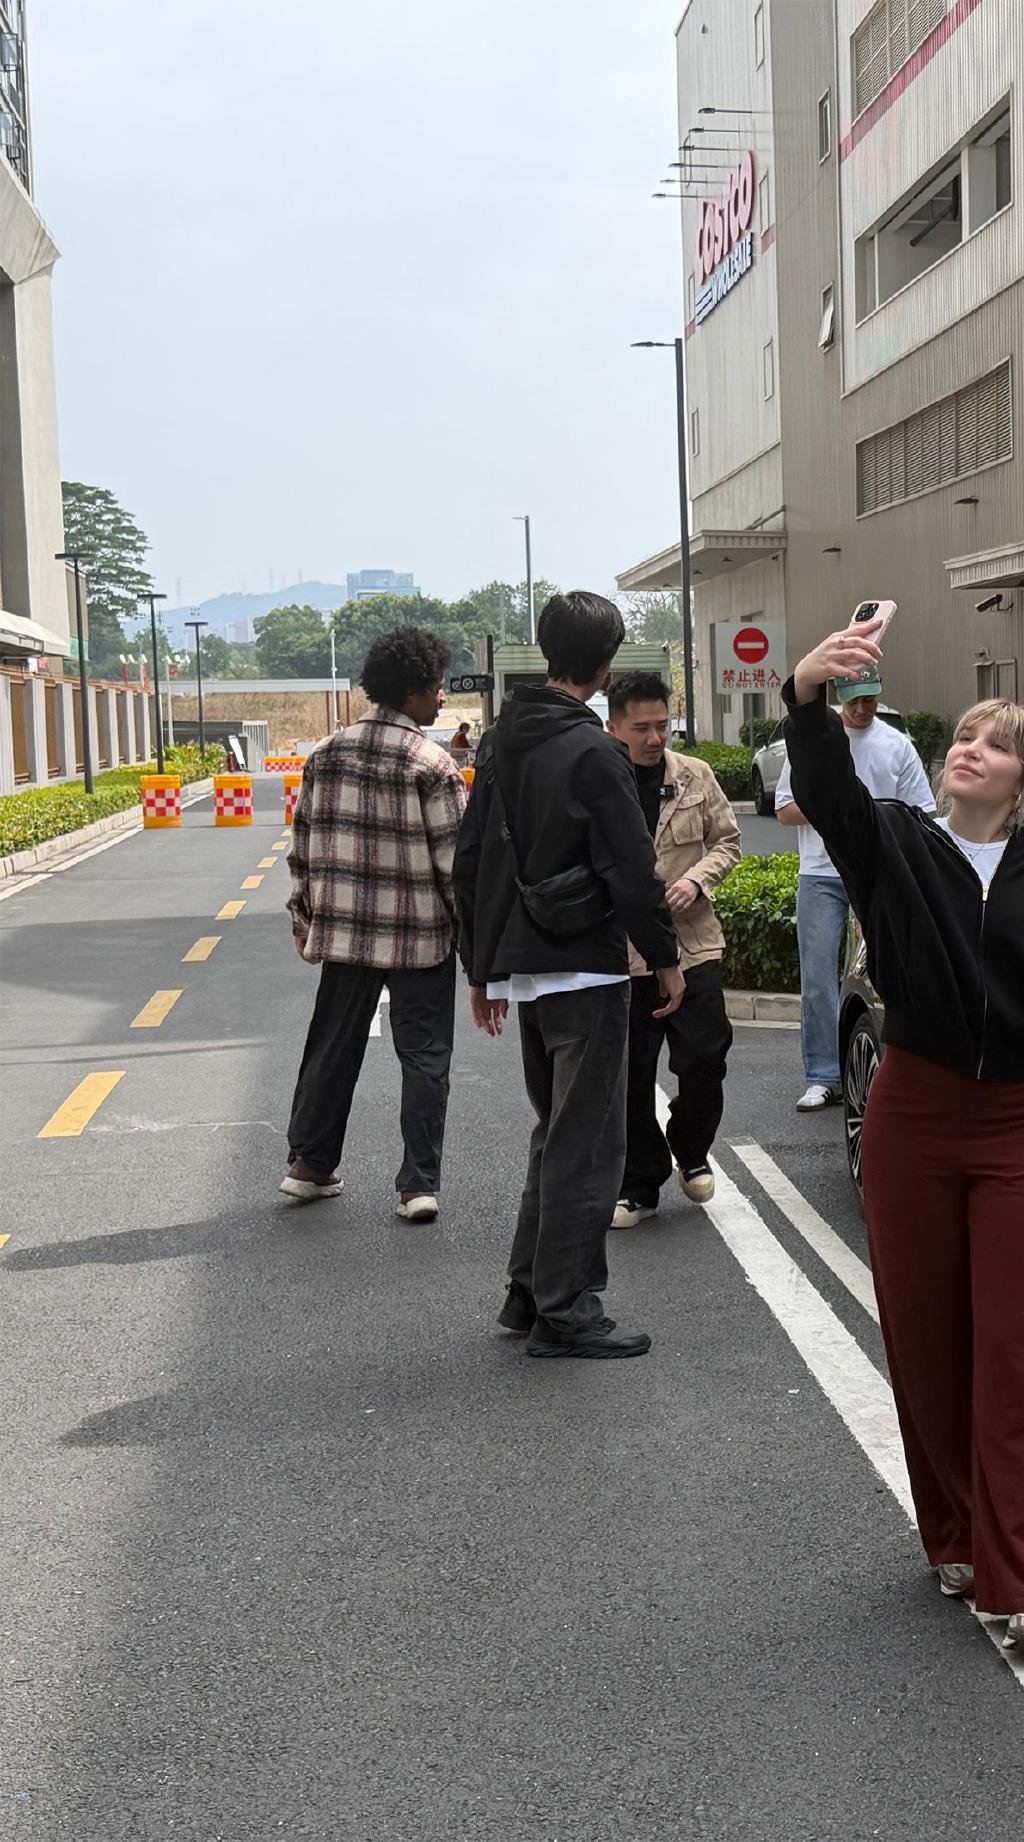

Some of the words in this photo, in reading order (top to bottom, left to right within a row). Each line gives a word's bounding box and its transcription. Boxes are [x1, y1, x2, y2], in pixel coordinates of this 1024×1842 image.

[695, 149, 755, 287] COSTCO
[711, 232, 754, 307] WHOLESALE
[722, 668, 781, 683] 禁止进入
